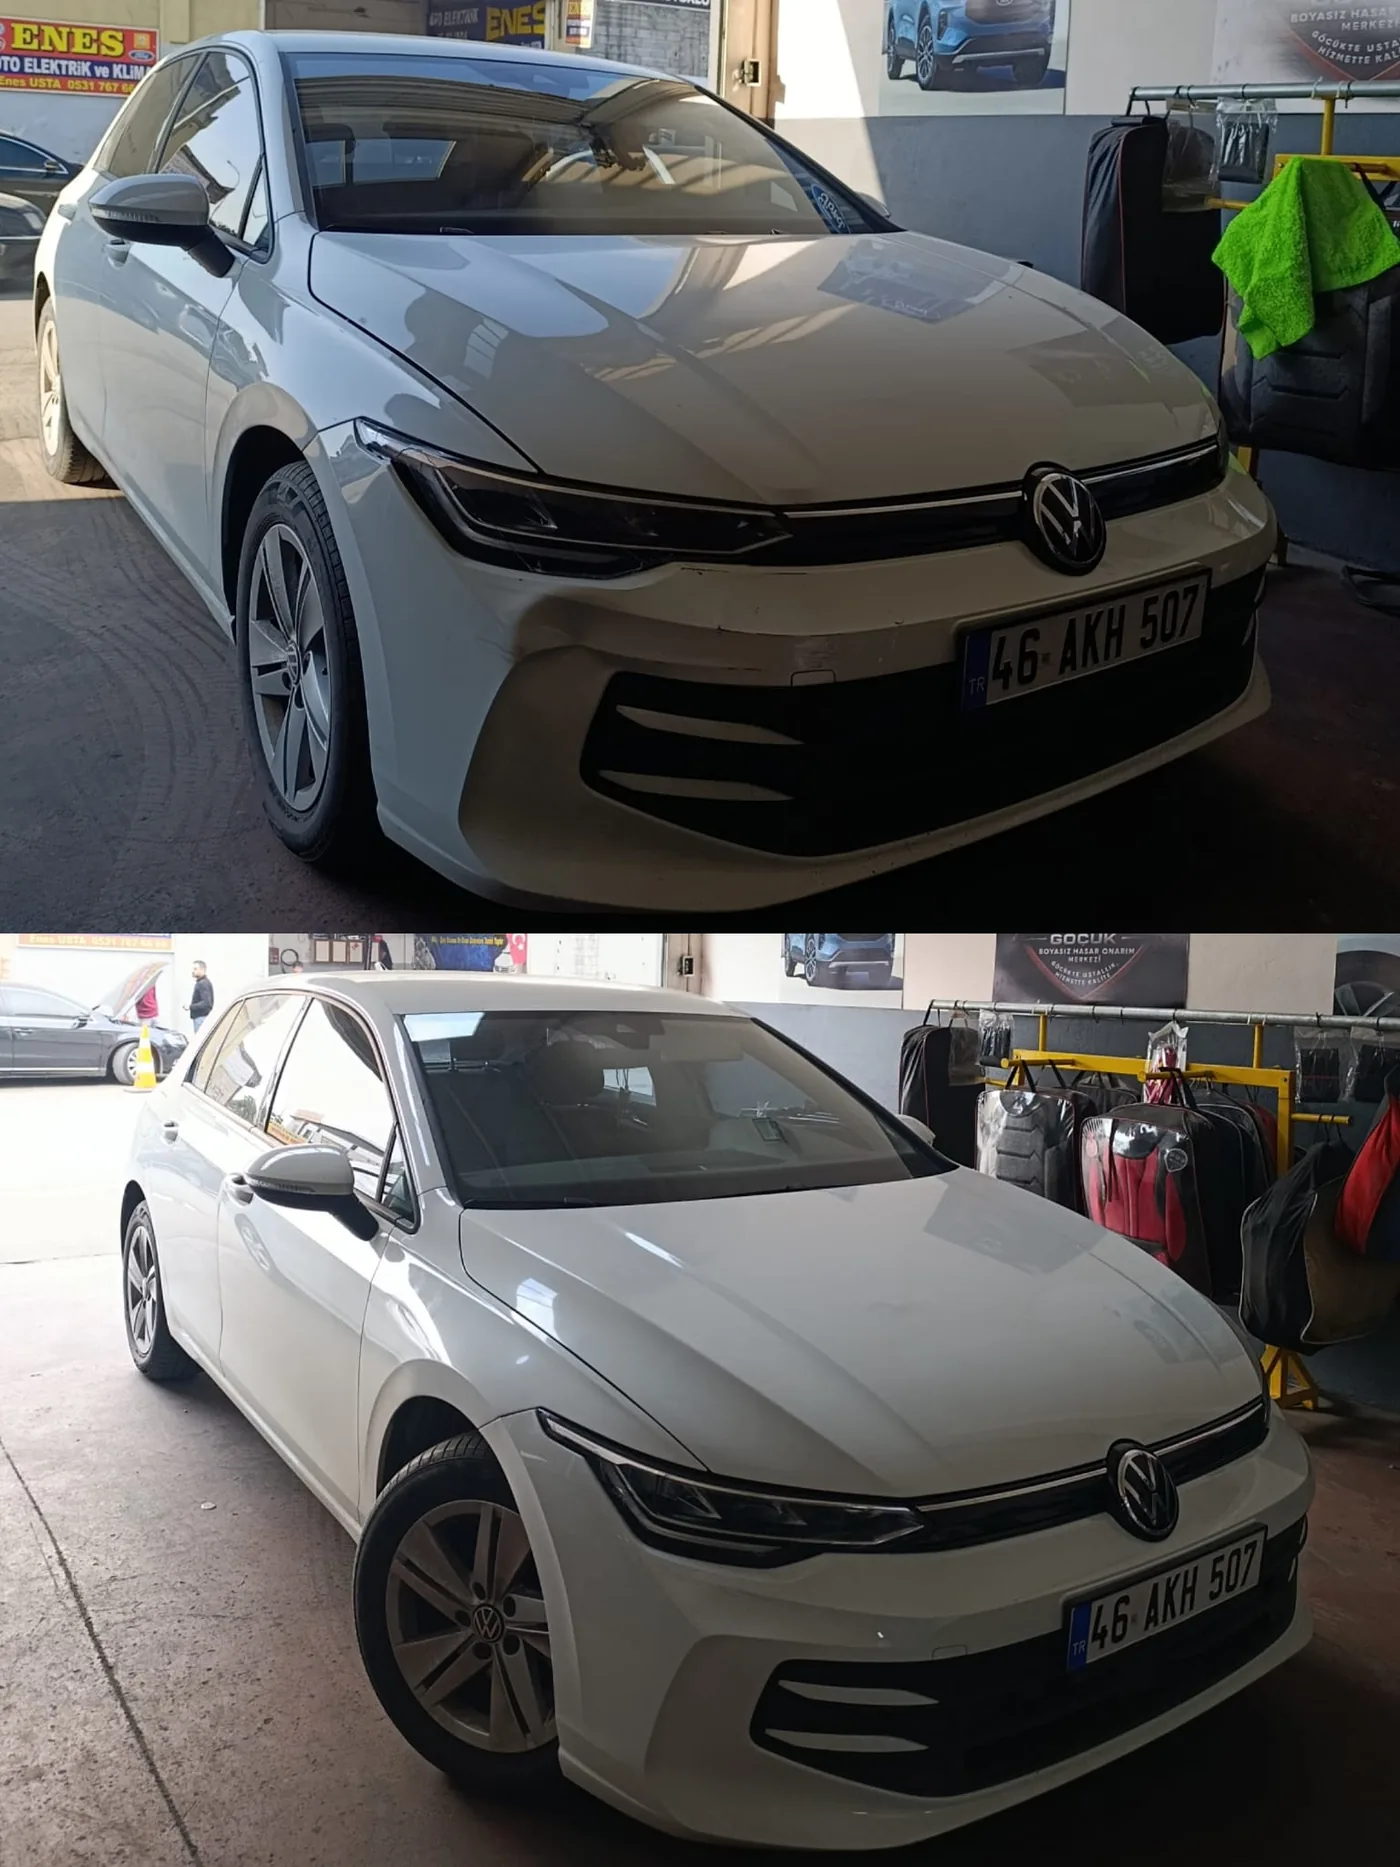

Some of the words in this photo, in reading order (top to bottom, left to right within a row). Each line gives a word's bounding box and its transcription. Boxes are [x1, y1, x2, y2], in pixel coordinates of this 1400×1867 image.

[486, 2, 545, 41] ENES
[1290, 10, 1347, 23] BOYASIZ
[11, 23, 124, 56] ENES
[1366, 38, 1400, 53] USTA
[1375, 47, 1400, 63] KAL
[0, 55, 20, 72] TO
[94, 66, 109, 78] ve
[0, 76, 26, 87] Enes
[29, 77, 61, 89] USTA
[68, 79, 94, 90] 0531
[99, 81, 120, 92] 767
[992, 628, 1041, 690] 46
[1058, 604, 1126, 675] AKH
[1140, 583, 1199, 649] 507
[968, 676, 985, 695] TR
[1073, 947, 1100, 955] HASAR
[1091, 1594, 1130, 1649] 46
[1144, 1565, 1199, 1631] AKH
[1209, 1540, 1258, 1600] 507
[1072, 1640, 1085, 1656] TR
